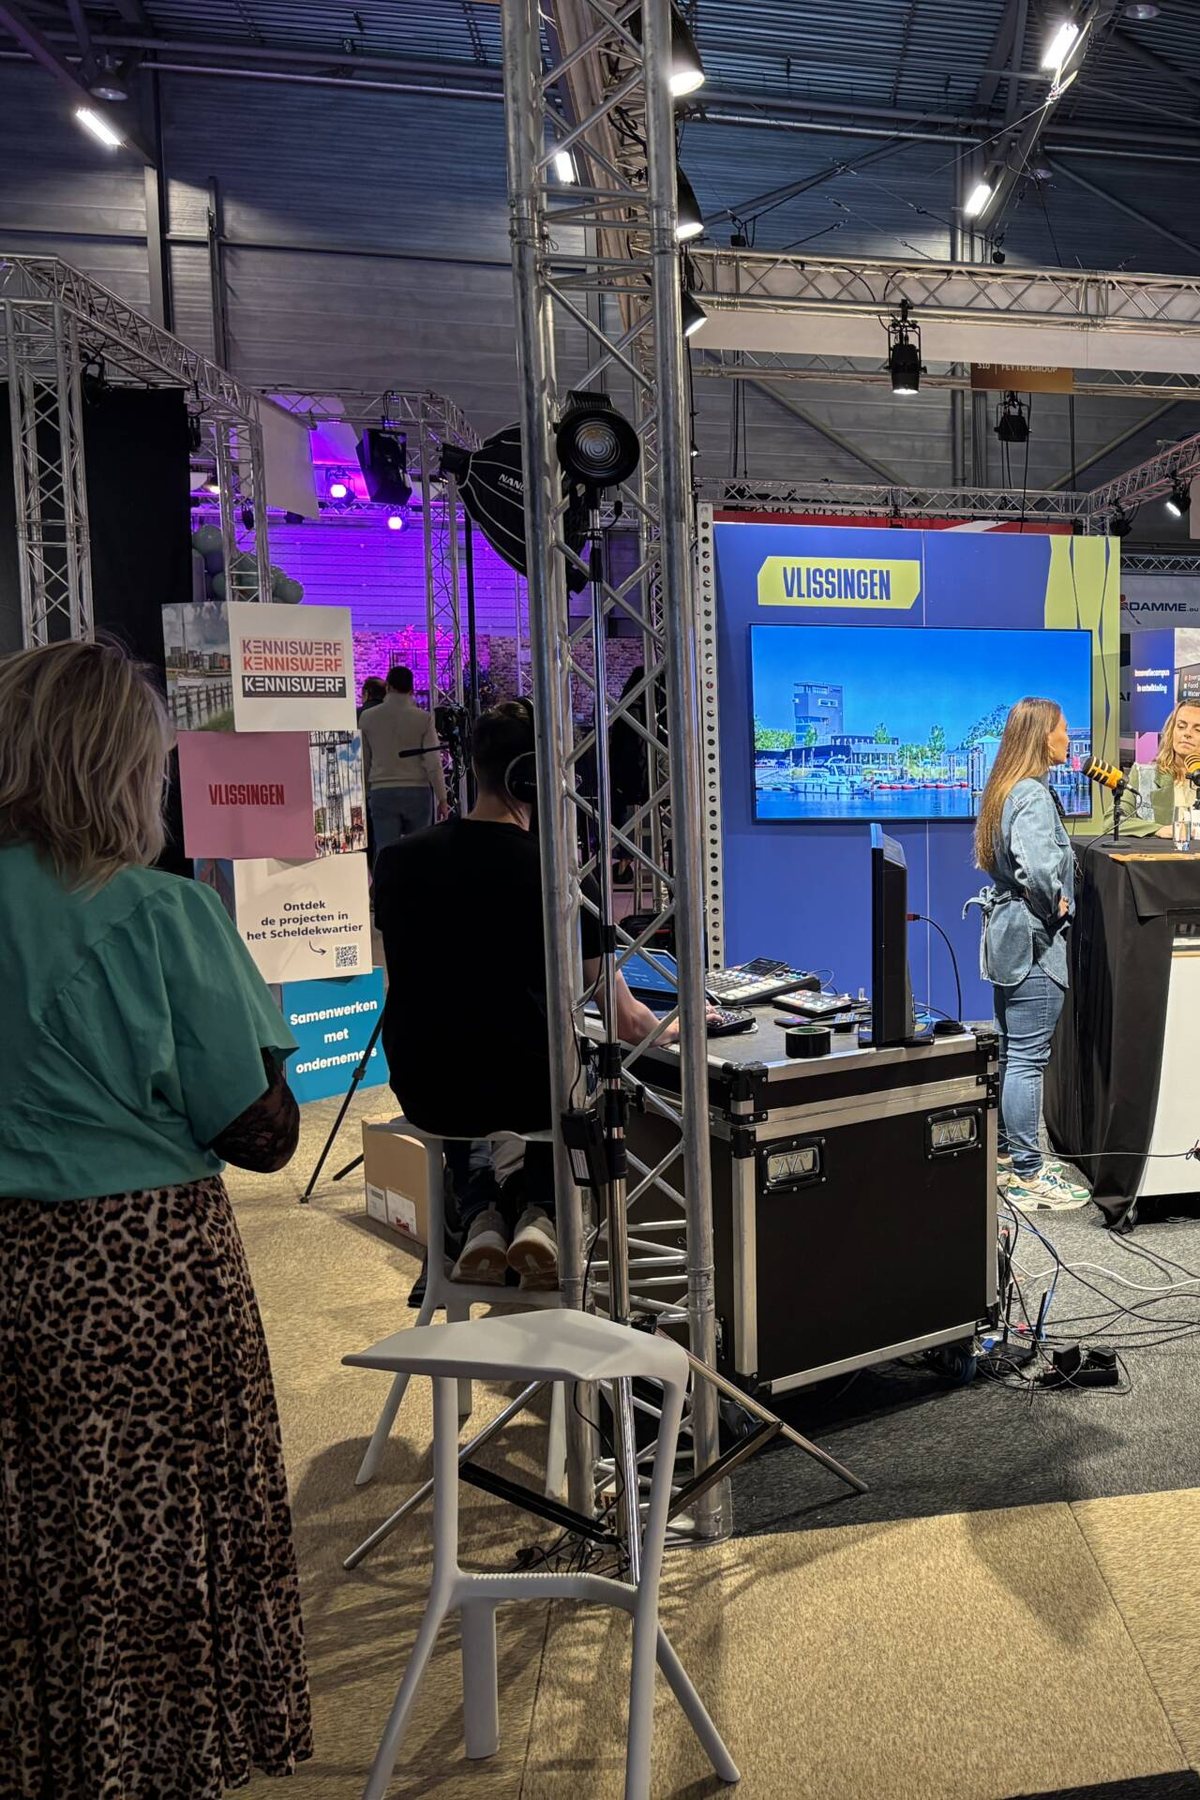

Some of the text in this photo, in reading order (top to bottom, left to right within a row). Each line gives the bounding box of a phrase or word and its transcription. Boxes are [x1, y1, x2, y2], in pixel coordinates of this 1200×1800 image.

[498, 473, 524, 491] NAN
[783, 567, 891, 600] VLISSINGEN
[242, 640, 342, 656] KENNISWERF
[243, 656, 342, 672] KENNISWERF
[244, 677, 344, 692] KENNISWERF
[208, 784, 285, 805] VLISSINGEN
[283, 900, 326, 912] Ontdek
[261, 911, 348, 927] de projecten in
[247, 923, 363, 940] het Scheldekwartier
[290, 1000, 378, 1026] Samenwerken
[324, 1028, 349, 1043] met
[296, 1047, 378, 1074] ondernemes
